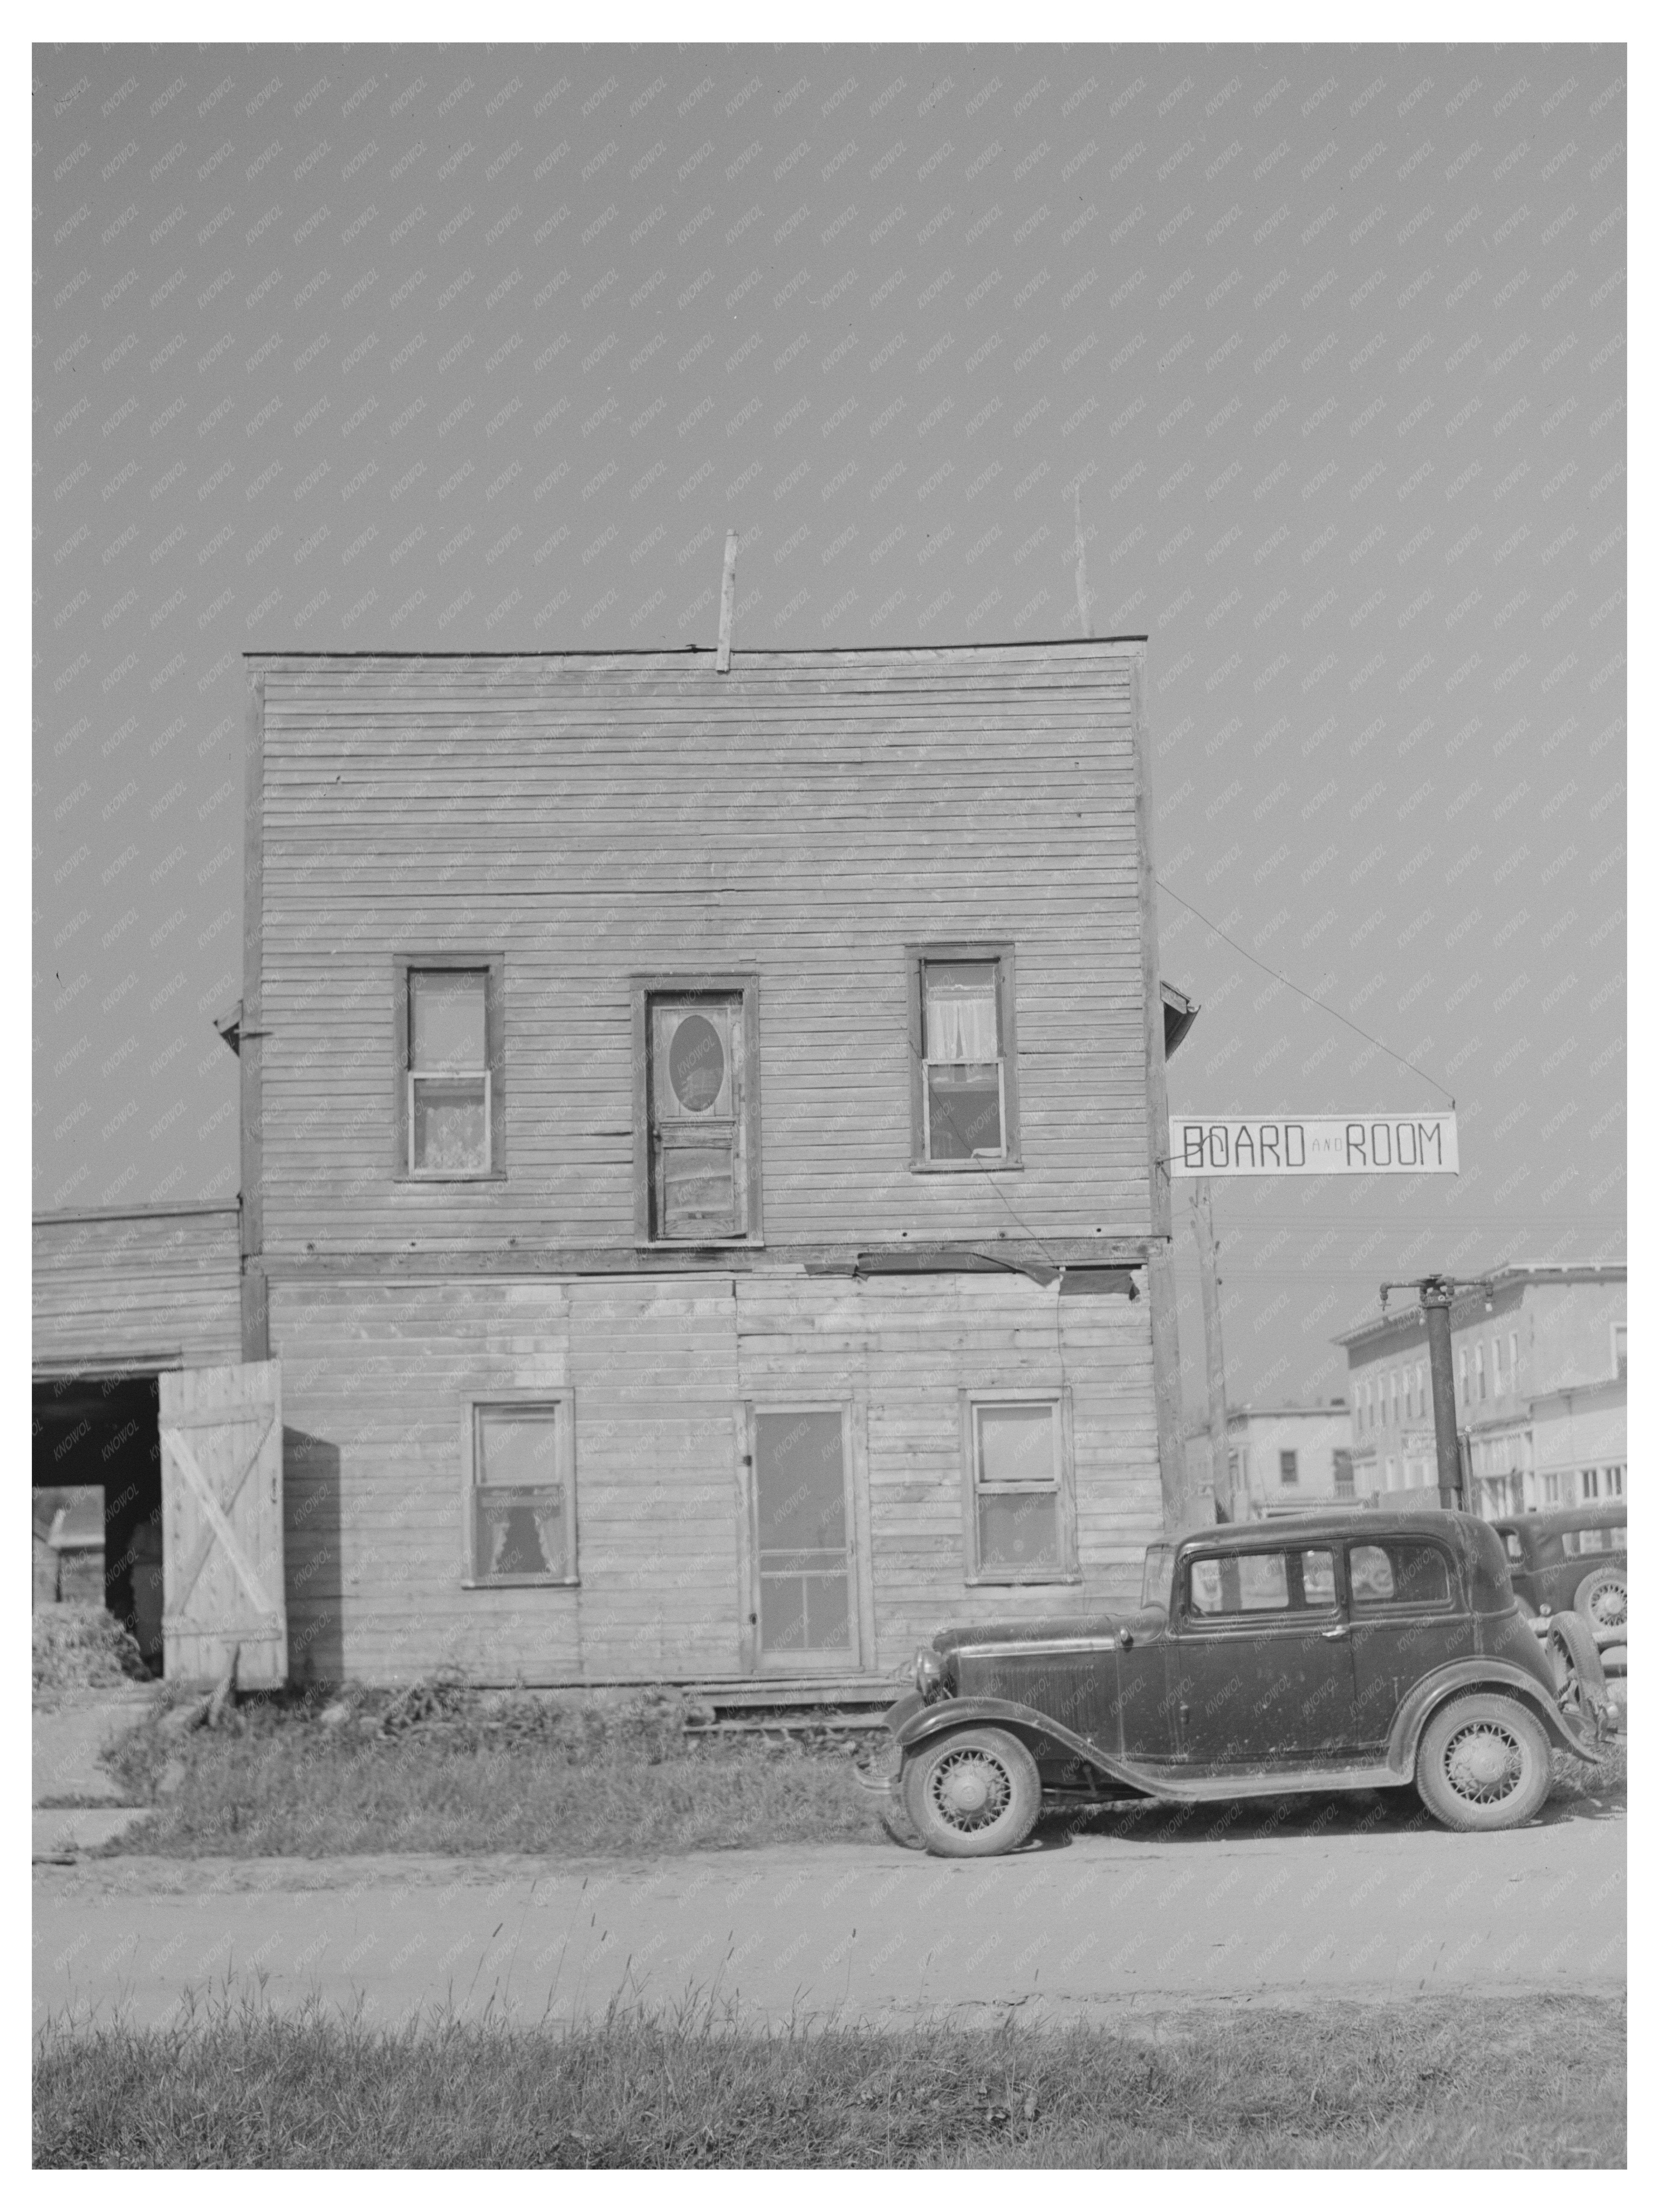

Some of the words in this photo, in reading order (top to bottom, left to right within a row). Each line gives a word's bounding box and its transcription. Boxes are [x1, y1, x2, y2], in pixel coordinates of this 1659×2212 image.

[1184, 1125, 1305, 1167] BOARD
[1312, 1138, 1342, 1151] AND
[1346, 1123, 1442, 1166] ROOM
